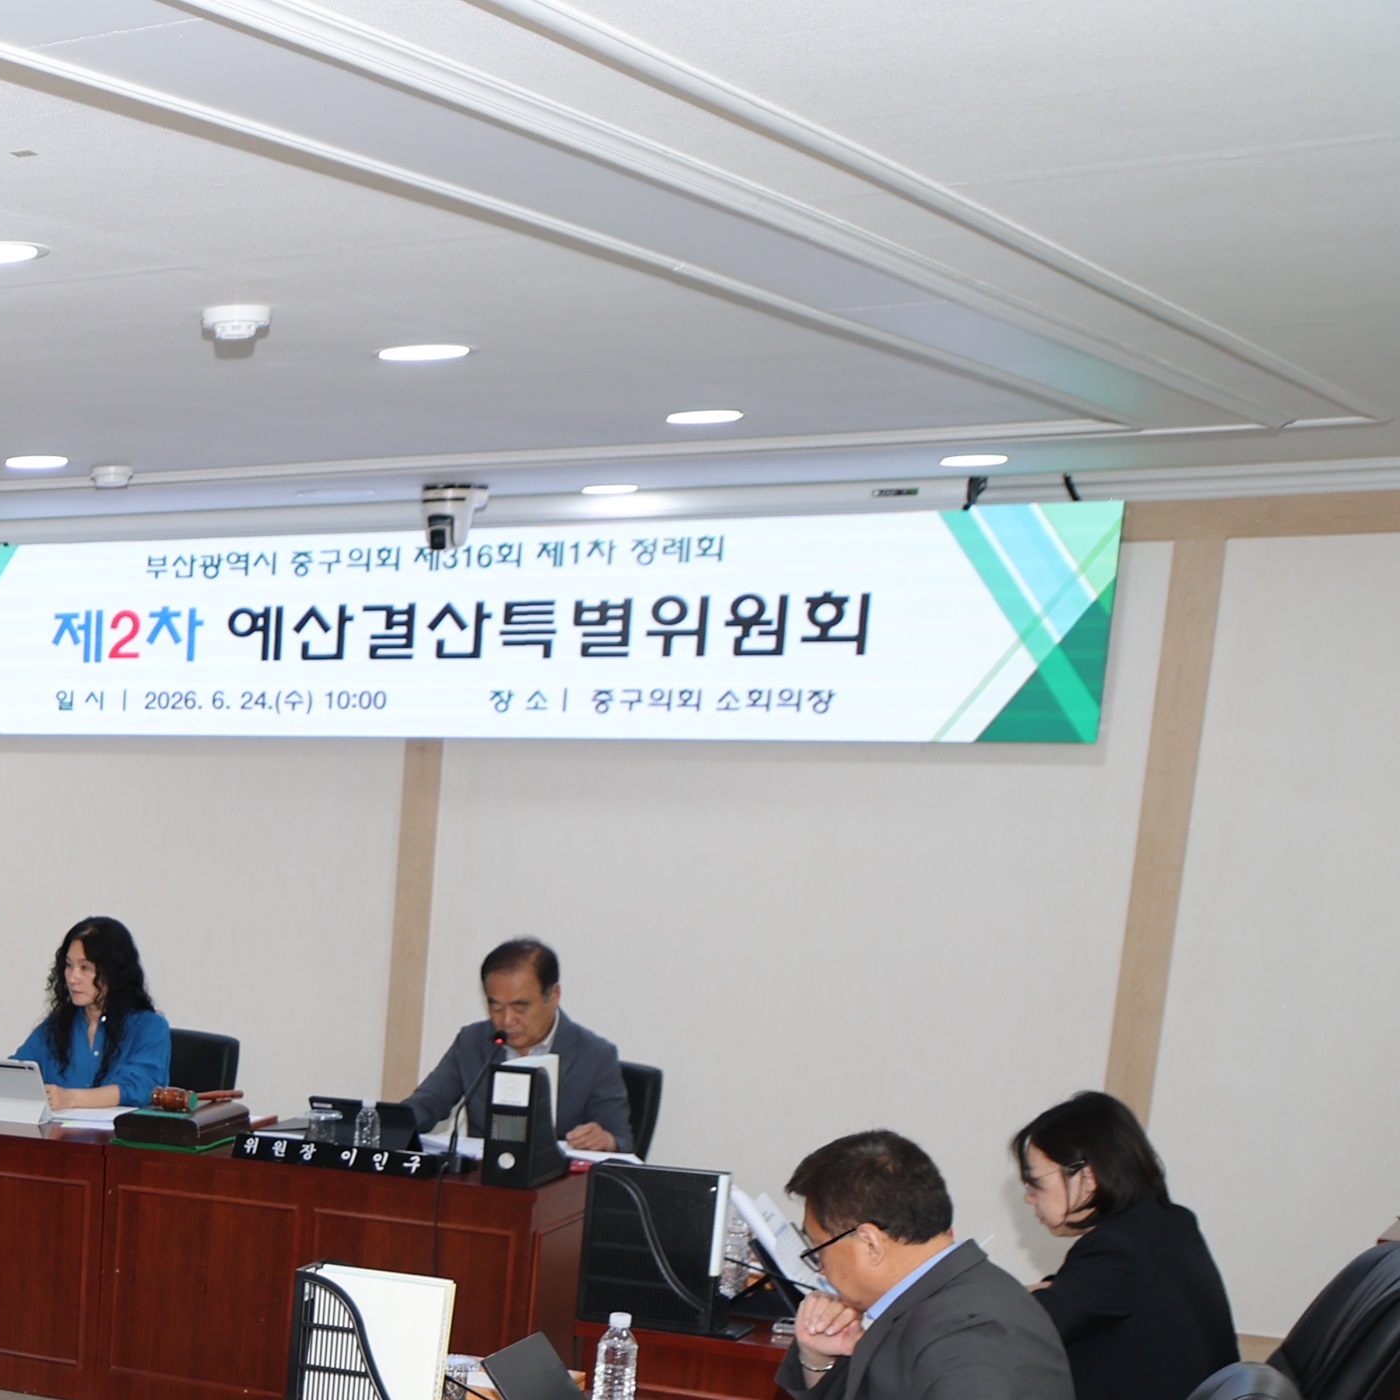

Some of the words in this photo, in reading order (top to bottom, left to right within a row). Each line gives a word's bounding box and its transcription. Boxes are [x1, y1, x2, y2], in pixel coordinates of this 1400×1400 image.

[146, 551, 277, 579] 부산광역시
[291, 546, 401, 577] 중구의회
[414, 542, 523, 571] 제316회
[537, 538, 617, 568] 제1차
[631, 535, 725, 566] 정례회
[52, 606, 204, 663] 제2차
[227, 591, 872, 661] 예산결산특별위원회
[144, 690, 203, 710] 2026.
[211, 691, 231, 710] 6.
[325, 690, 387, 710] 10:00
[591, 688, 702, 714] 중구의회
[715, 687, 836, 714] 소회의장
[243, 1137, 317, 1161] 위원장
[340, 1148, 421, 1174] 이인구
